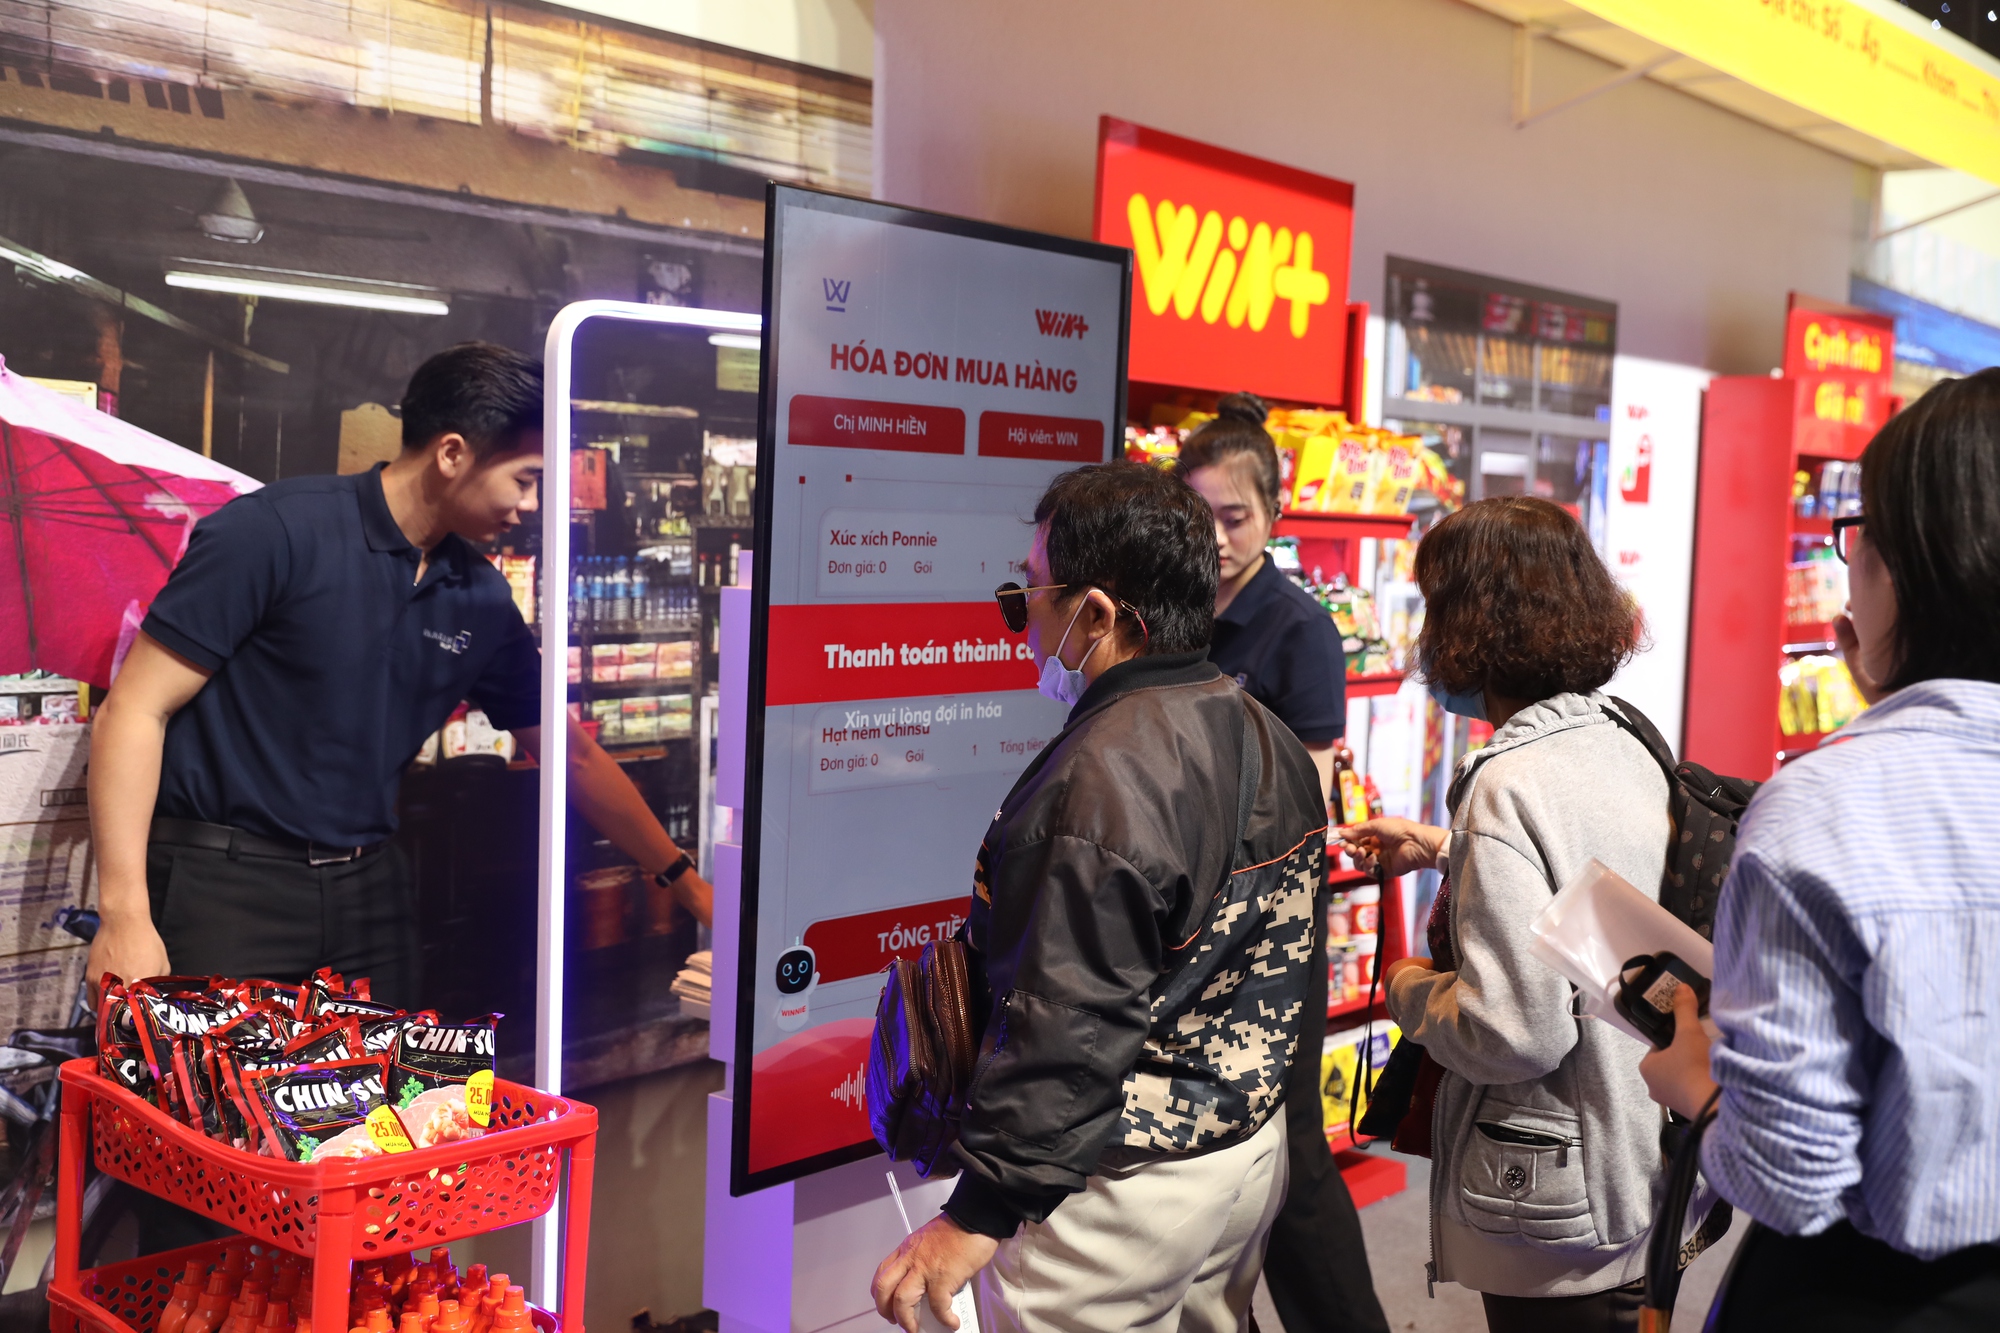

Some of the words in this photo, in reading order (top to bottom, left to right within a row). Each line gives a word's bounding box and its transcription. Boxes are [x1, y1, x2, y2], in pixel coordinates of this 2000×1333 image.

[830, 339, 888, 375] HÓA
[894, 350, 948, 381] ĐƠN
[955, 358, 1009, 388] MUA
[1014, 359, 1078, 394] HÀNG
[833, 414, 855, 434] Chị
[858, 416, 893, 434] MINH
[896, 415, 927, 436] HIỀN
[1008, 427, 1027, 445] Hội
[1029, 428, 1054, 444] viên:
[1056, 430, 1079, 446] WIN
[830, 529, 857, 546] Xúc
[861, 529, 888, 546] xích
[892, 531, 938, 547] Ponnie
[828, 560, 851, 574] Đơn
[855, 560, 876, 577] giá:
[879, 560, 887, 574] 0
[913, 560, 933, 574] Gói
[980, 561, 985, 573] 1
[824, 642, 895, 669] Thanh
[900, 639, 948, 666] toán
[953, 637, 1011, 663] thành
[844, 710, 869, 729] Xin
[874, 707, 895, 726] vui
[900, 706, 931, 727] lòng
[935, 704, 957, 726] đợi
[960, 704, 973, 720] in
[977, 702, 1002, 719] hóa
[822, 727, 847, 746] Hạt
[885, 722, 931, 738] Chinsu
[905, 750, 924, 763] Gói
[972, 744, 977, 756] 1
[820, 757, 844, 771] Đơn
[847, 754, 868, 772] giá:
[870, 753, 879, 766] 0
[877, 922, 931, 953] TỔNG
[781, 1005, 807, 1017] WINNIE
[274, 1074, 385, 1112] CHIN-SU
